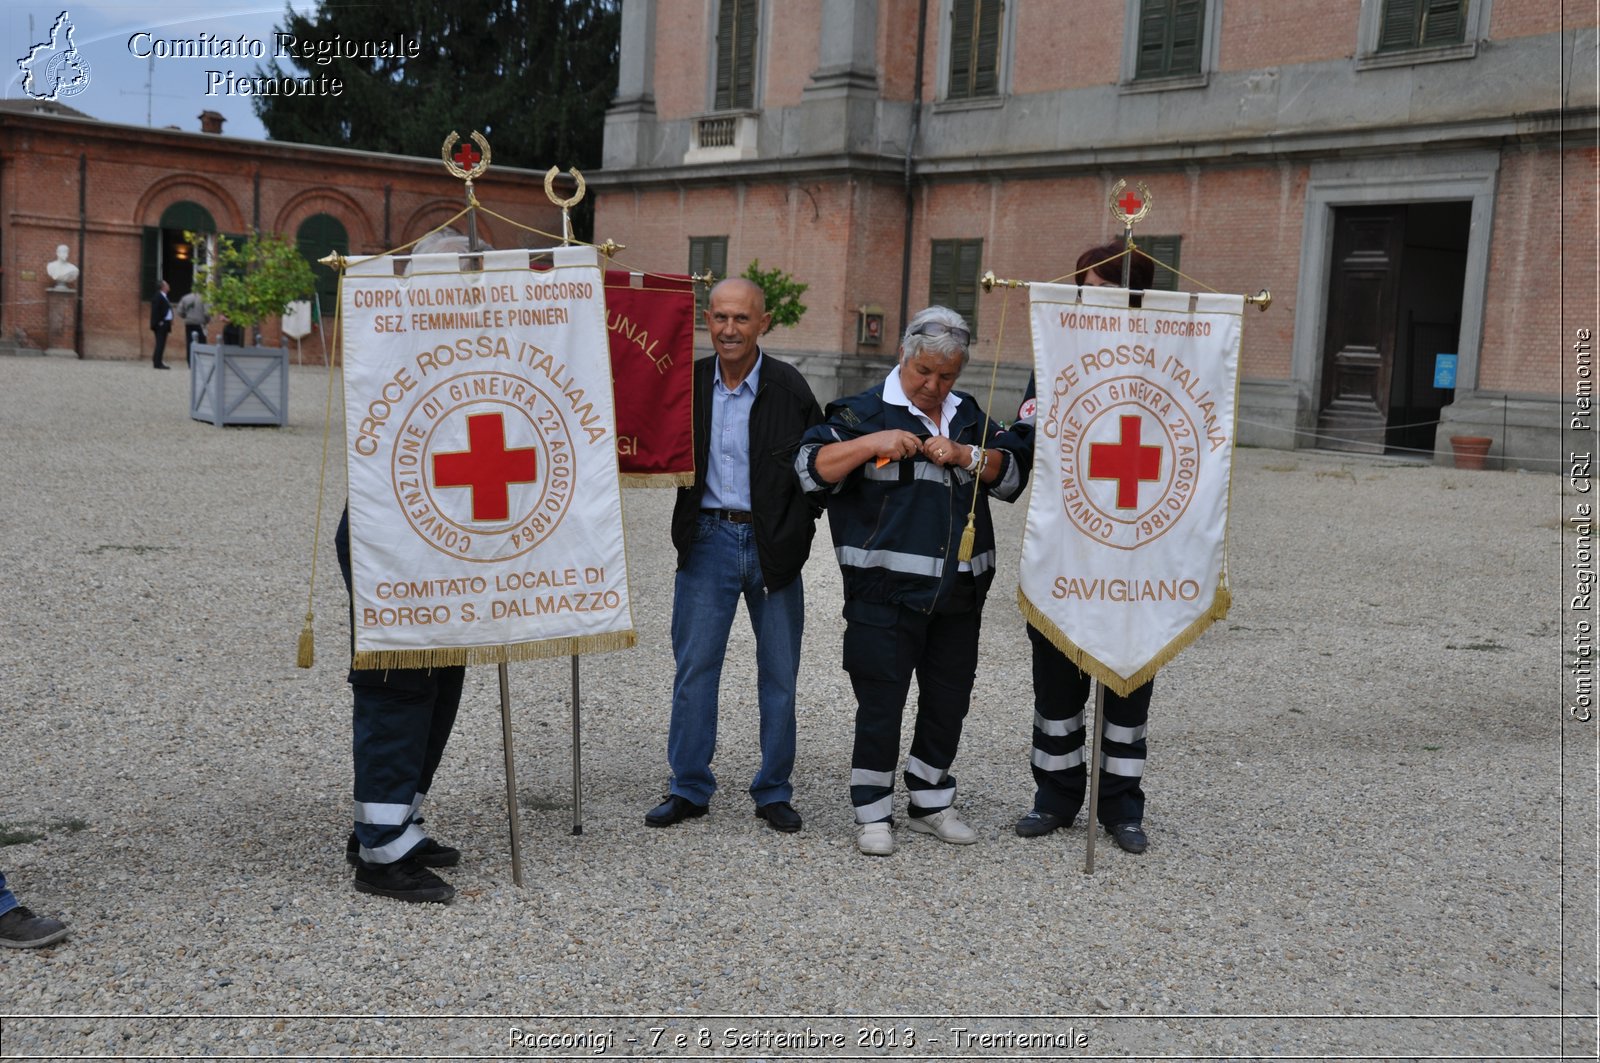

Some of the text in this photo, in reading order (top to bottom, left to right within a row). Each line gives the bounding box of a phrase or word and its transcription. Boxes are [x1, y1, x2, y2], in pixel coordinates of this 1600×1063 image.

[354, 282, 593, 308] CORPO VOLONTARI DEL SOCCORSO
[374, 307, 569, 334] SEZ. FEMMINILE E PIONIERI
[1060, 312, 1121, 332] VOONTARI
[1128, 318, 1149, 334] DEL
[607, 309, 675, 375] UNALE
[355, 336, 608, 457] CROCE ROSSA ITALIANA
[1081, 344, 1156, 376] ROSSA
[1161, 355, 1227, 453] ITALIANA
[1081, 396, 1103, 415] DI
[1109, 381, 1173, 418] GINEVRA
[617, 436, 637, 455] GI
[1169, 418, 1191, 441] 22
[399, 376, 570, 554] CONVENZIONE DI GINEVRA 22 AGOSTO 1864
[1166, 445, 1195, 511] AGOSTO
[1135, 509, 1171, 541] 186
[376, 567, 606, 601] COMITATO LOCALE DI
[1051, 575, 1200, 602] SAVIGLIANO
[363, 590, 621, 626] BORGO S. DALMAZZO
